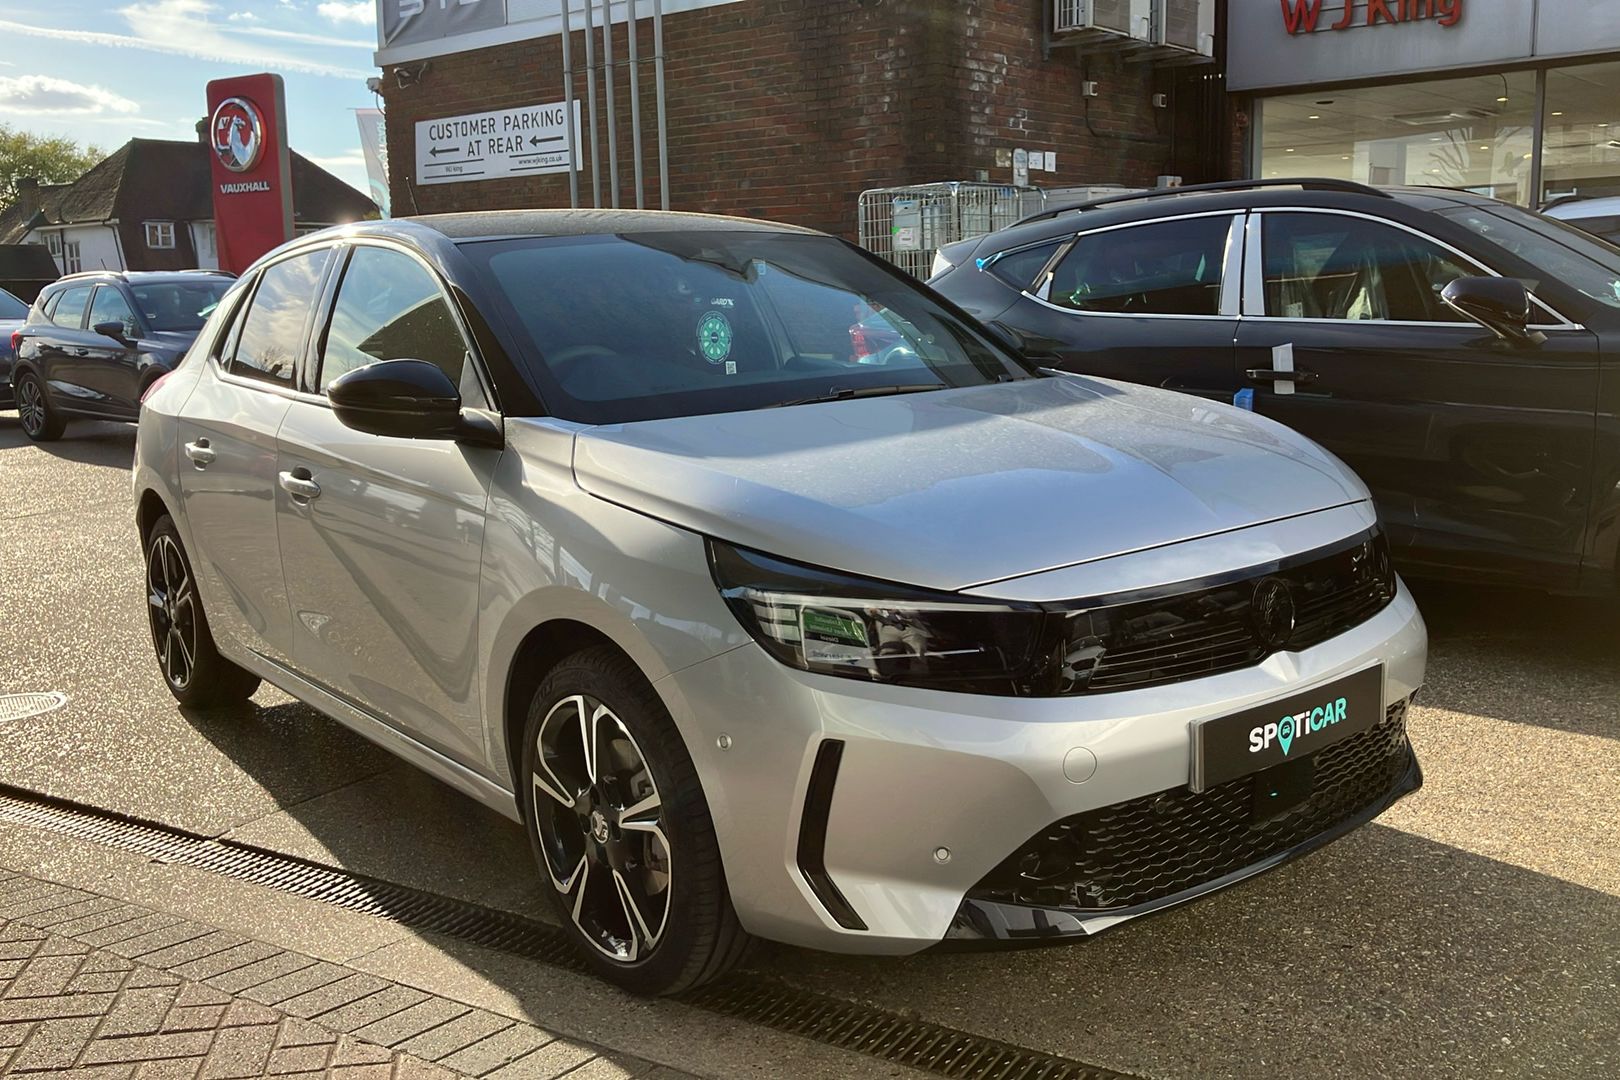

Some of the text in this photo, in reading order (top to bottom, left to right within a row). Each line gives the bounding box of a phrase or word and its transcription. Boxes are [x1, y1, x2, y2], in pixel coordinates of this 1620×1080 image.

[429, 108, 564, 141] CUSTOMER PARKING
[467, 135, 524, 157] AT REAR
[220, 181, 270, 194] VAUXHALL
